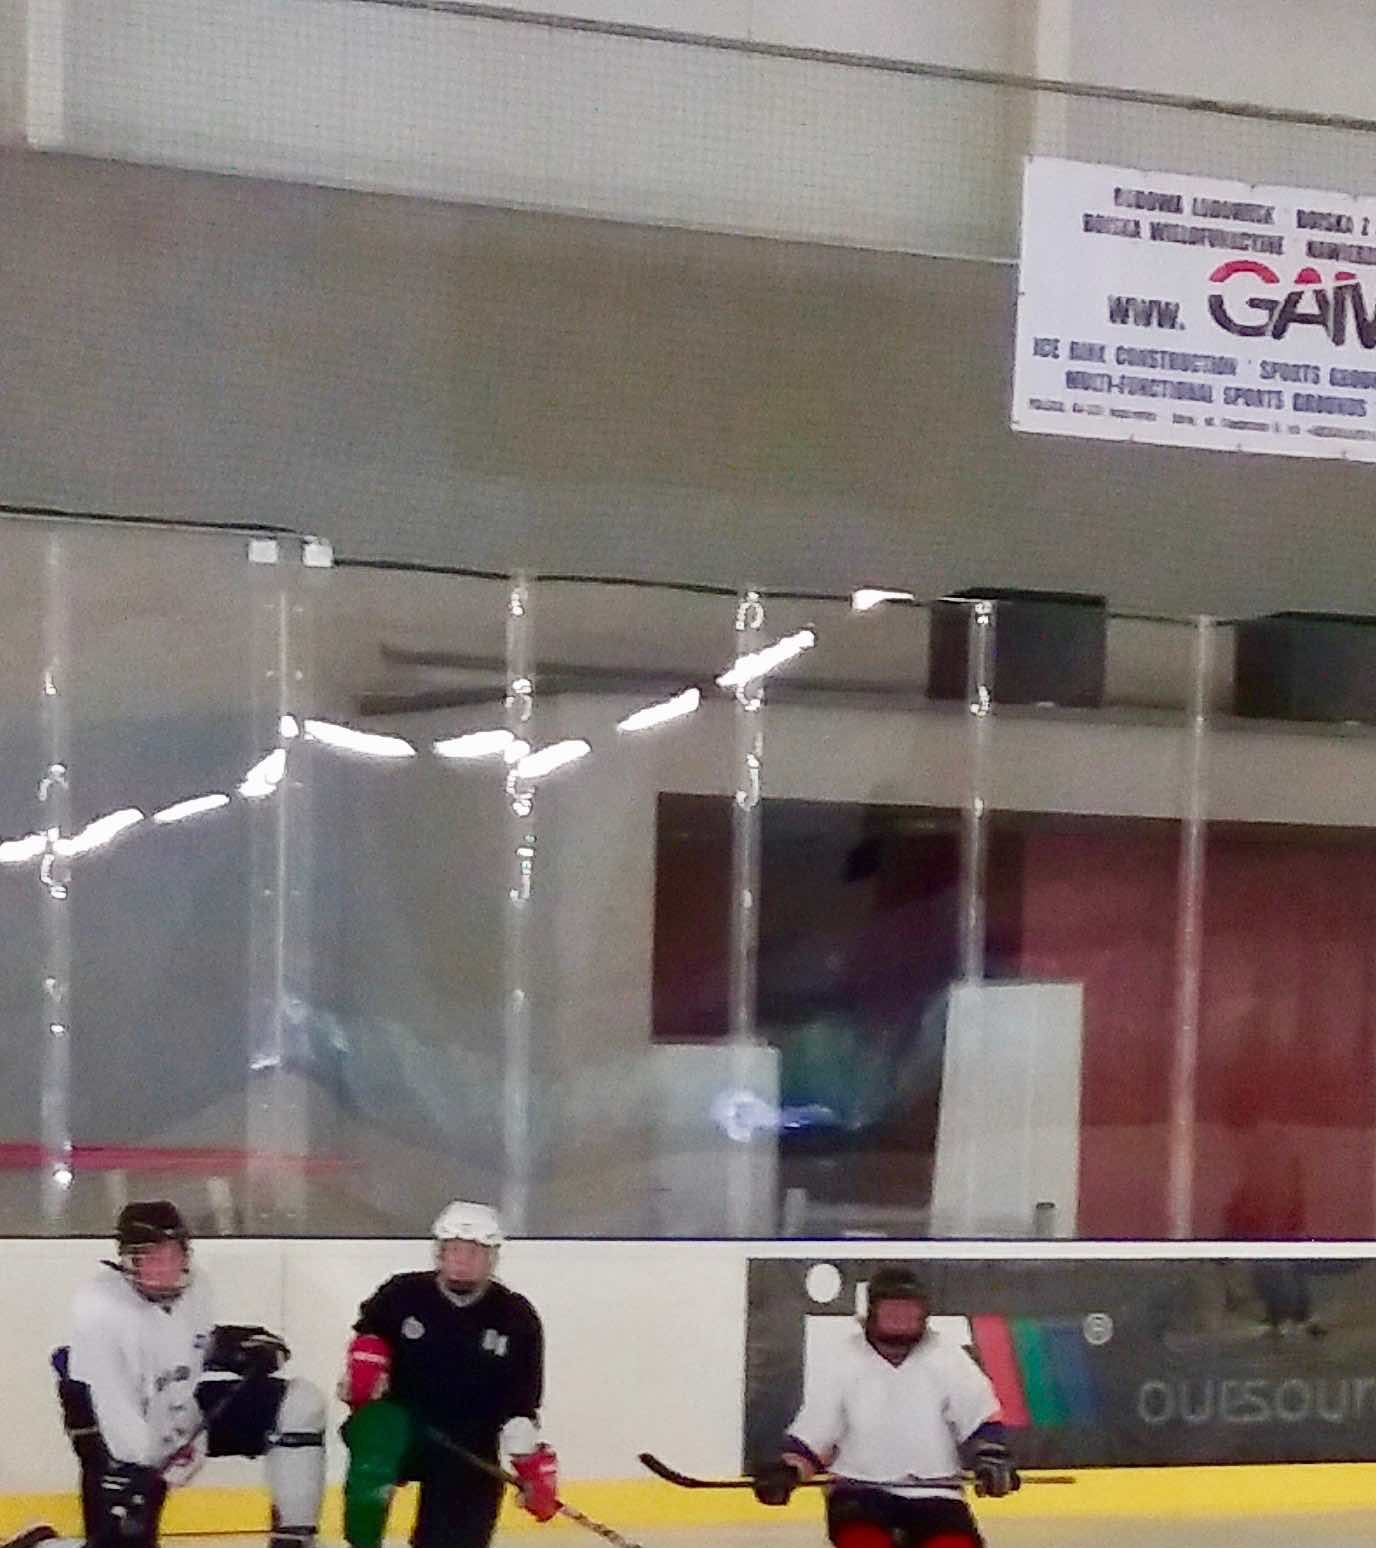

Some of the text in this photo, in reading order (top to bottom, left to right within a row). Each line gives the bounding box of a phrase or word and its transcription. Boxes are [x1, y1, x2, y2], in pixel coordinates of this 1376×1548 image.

[1116, 345, 1237, 376] CONSTRUCTION
[1259, 360, 1321, 385] SPORTS
[1223, 386, 1284, 410] SPORTS
